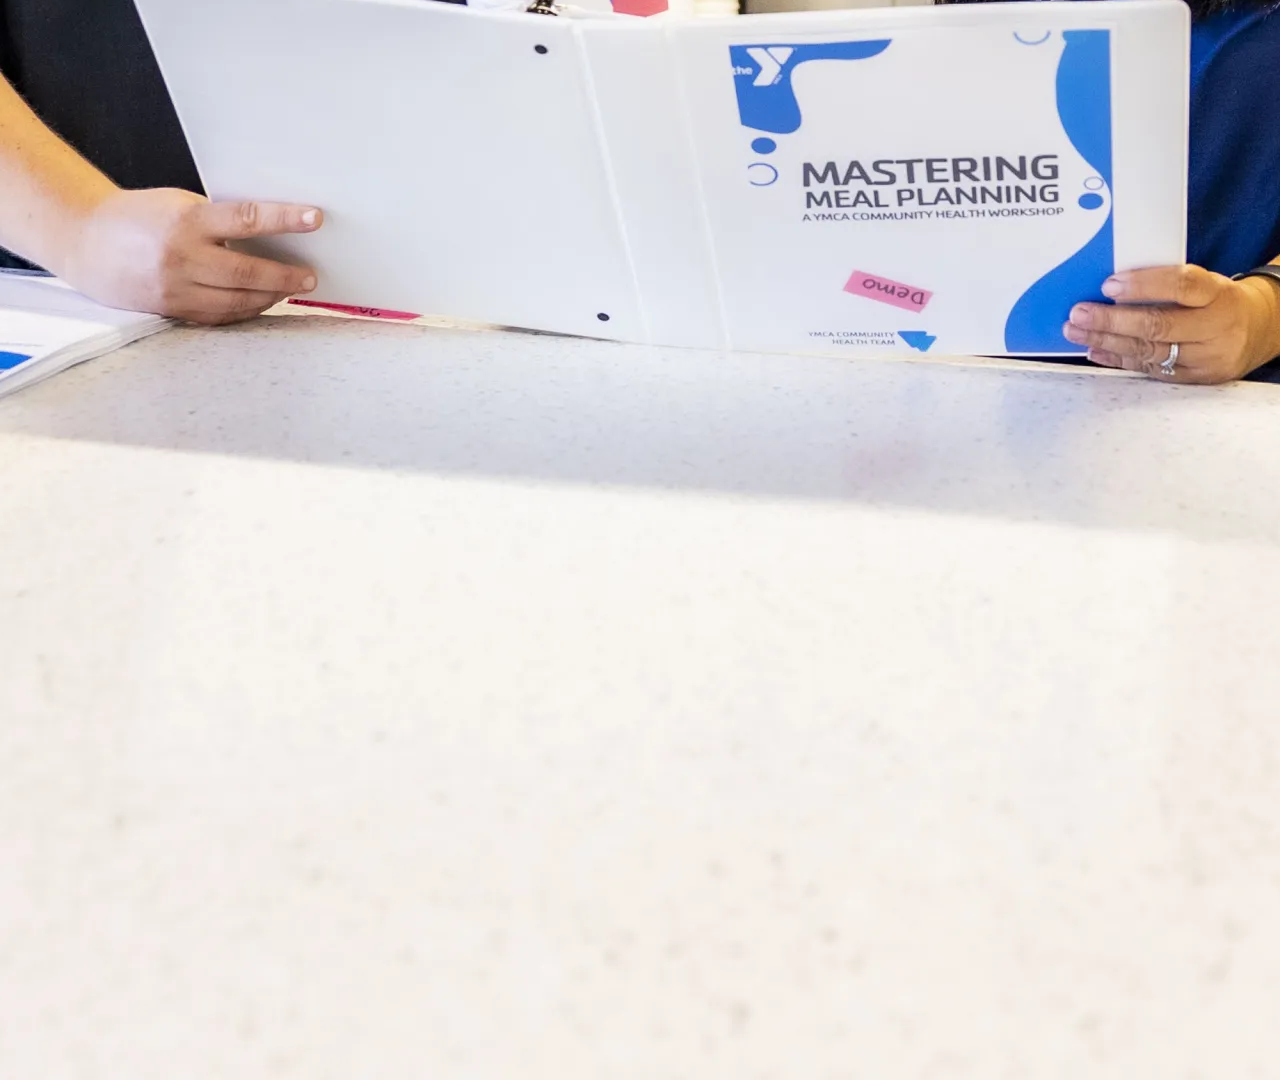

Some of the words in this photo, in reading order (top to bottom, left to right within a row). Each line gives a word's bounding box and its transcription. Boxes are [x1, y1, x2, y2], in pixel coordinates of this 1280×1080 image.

[732, 66, 753, 75] the
[803, 154, 1059, 188] MASTERING
[806, 188, 889, 209] MEAL
[896, 184, 1059, 207] PLANNING
[803, 213, 812, 221] A
[813, 212, 850, 221] YMCA
[852, 211, 934, 221] COMMUNITY
[935, 209, 985, 218] HEALTH
[988, 207, 1064, 217] WORKSHOP
[862, 278, 924, 305] Demo
